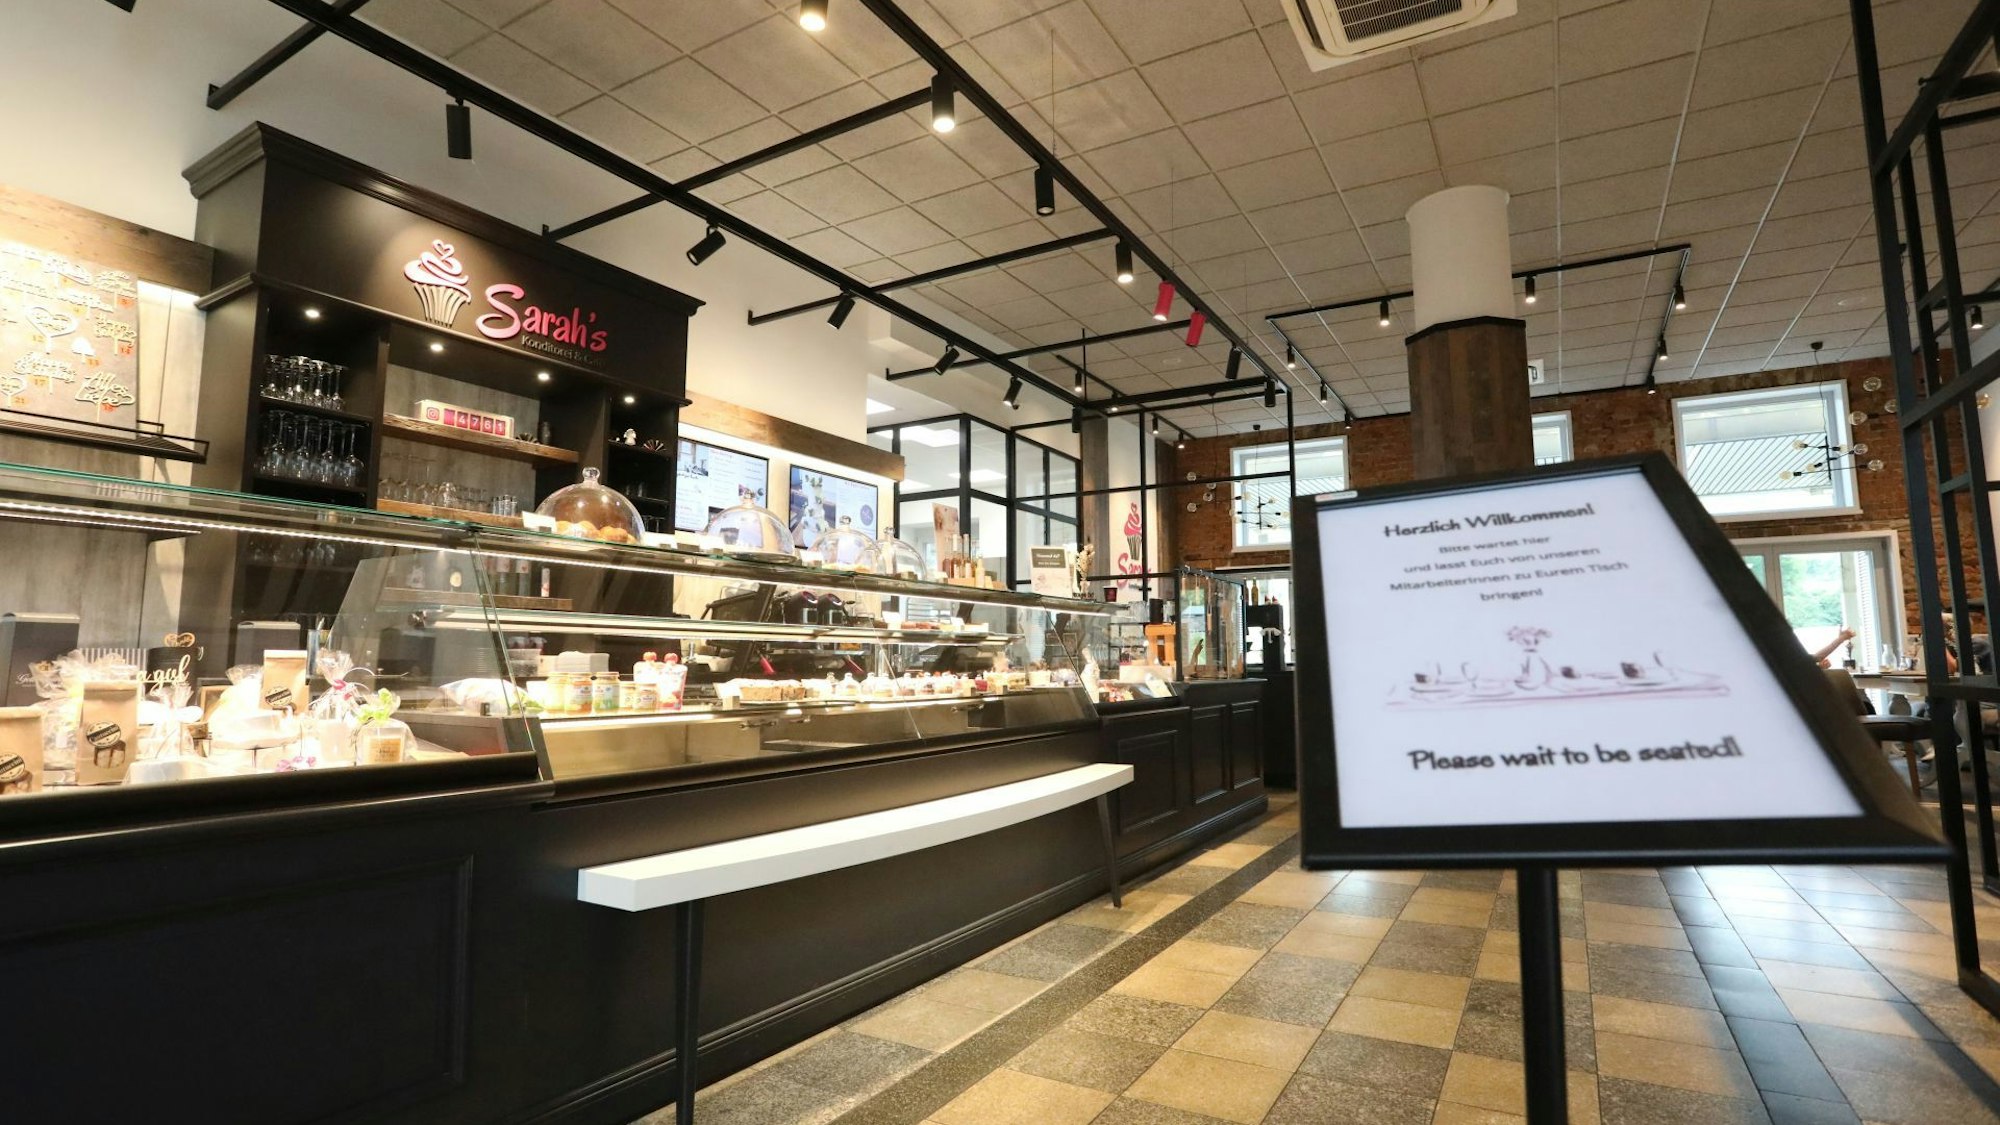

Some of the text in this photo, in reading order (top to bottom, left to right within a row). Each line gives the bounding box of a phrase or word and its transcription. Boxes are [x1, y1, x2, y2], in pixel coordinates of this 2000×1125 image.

[476, 284, 607, 352] Sarah's
[521, 334, 573, 360] Konditorei
[1383, 503, 1596, 538] Herzlich Willkommen!
[1439, 535, 1551, 554] Bitte wartet hier
[1403, 546, 1601, 574] und lasst Euch von unseren
[1514, 571, 1533, 580] zu
[1535, 564, 1585, 578] Eurem
[1589, 560, 1629, 573] Tisch
[1479, 587, 1544, 602] bringen!
[1408, 735, 1745, 771] Please wait to be seated!
